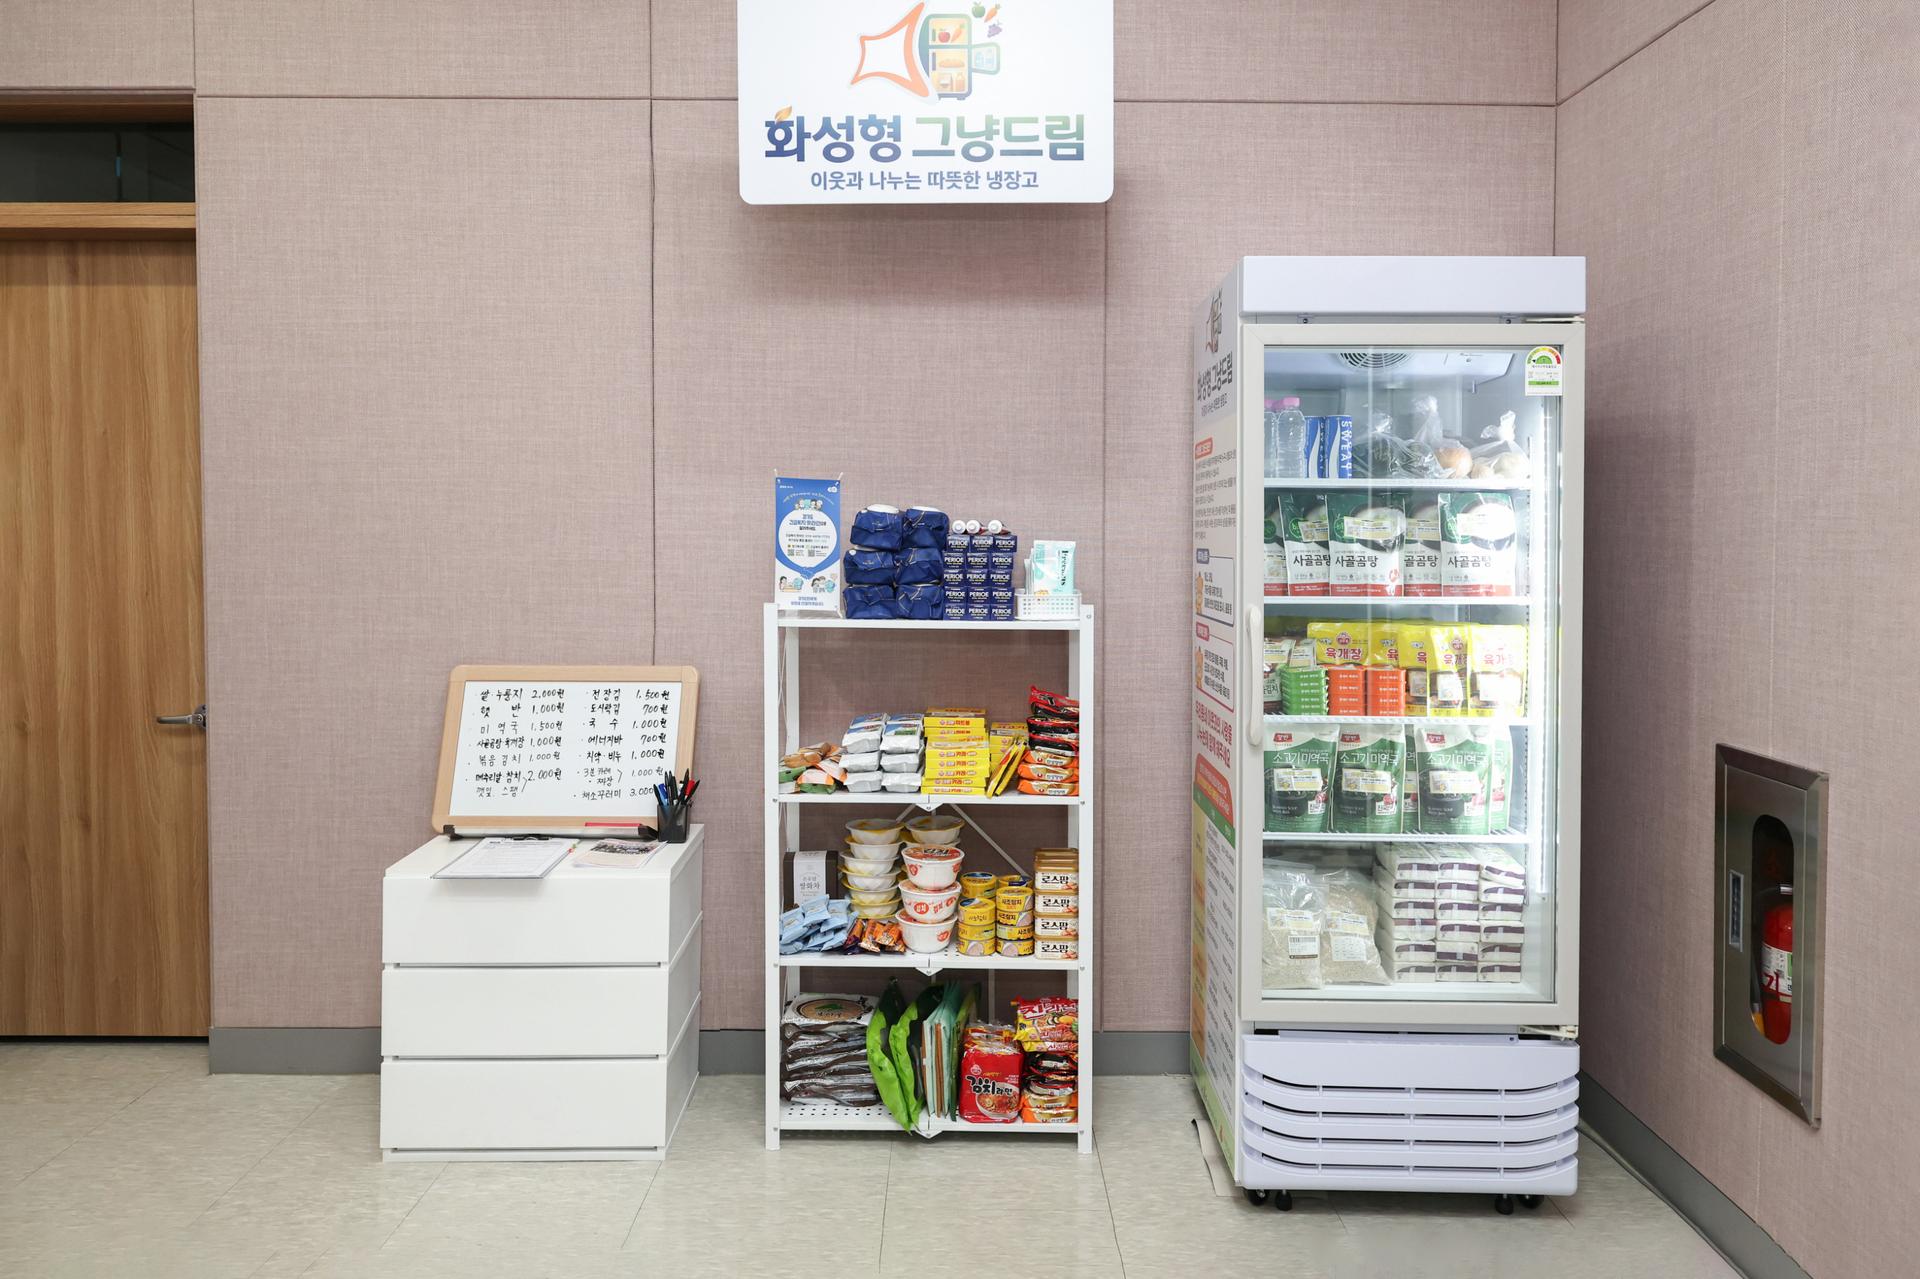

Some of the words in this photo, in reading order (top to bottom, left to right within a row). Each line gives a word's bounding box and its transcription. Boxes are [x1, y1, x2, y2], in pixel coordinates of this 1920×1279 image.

[765, 114, 901, 162] 화성형
[912, 114, 1084, 162] 그냥드림
[811, 170, 863, 190] 이웃과
[870, 171, 921, 190] 나누는
[928, 171, 980, 190] 따뜻한
[986, 170, 1038, 190] 냉장고
[1336, 554, 1378, 568] 사골곰탕
[1448, 554, 1492, 568] 사골곰탕
[1326, 647, 1362, 660] 육개장
[643, 704, 668, 716] 700원
[641, 732, 666, 744] 700원
[1041, 875, 1070, 885] 로스팜
[1042, 898, 1070, 908] 로스팜
[1041, 922, 1069, 931] 로스팜
[1041, 944, 1069, 954] 로스팜
[966, 1075, 1013, 1096] 김치라면
